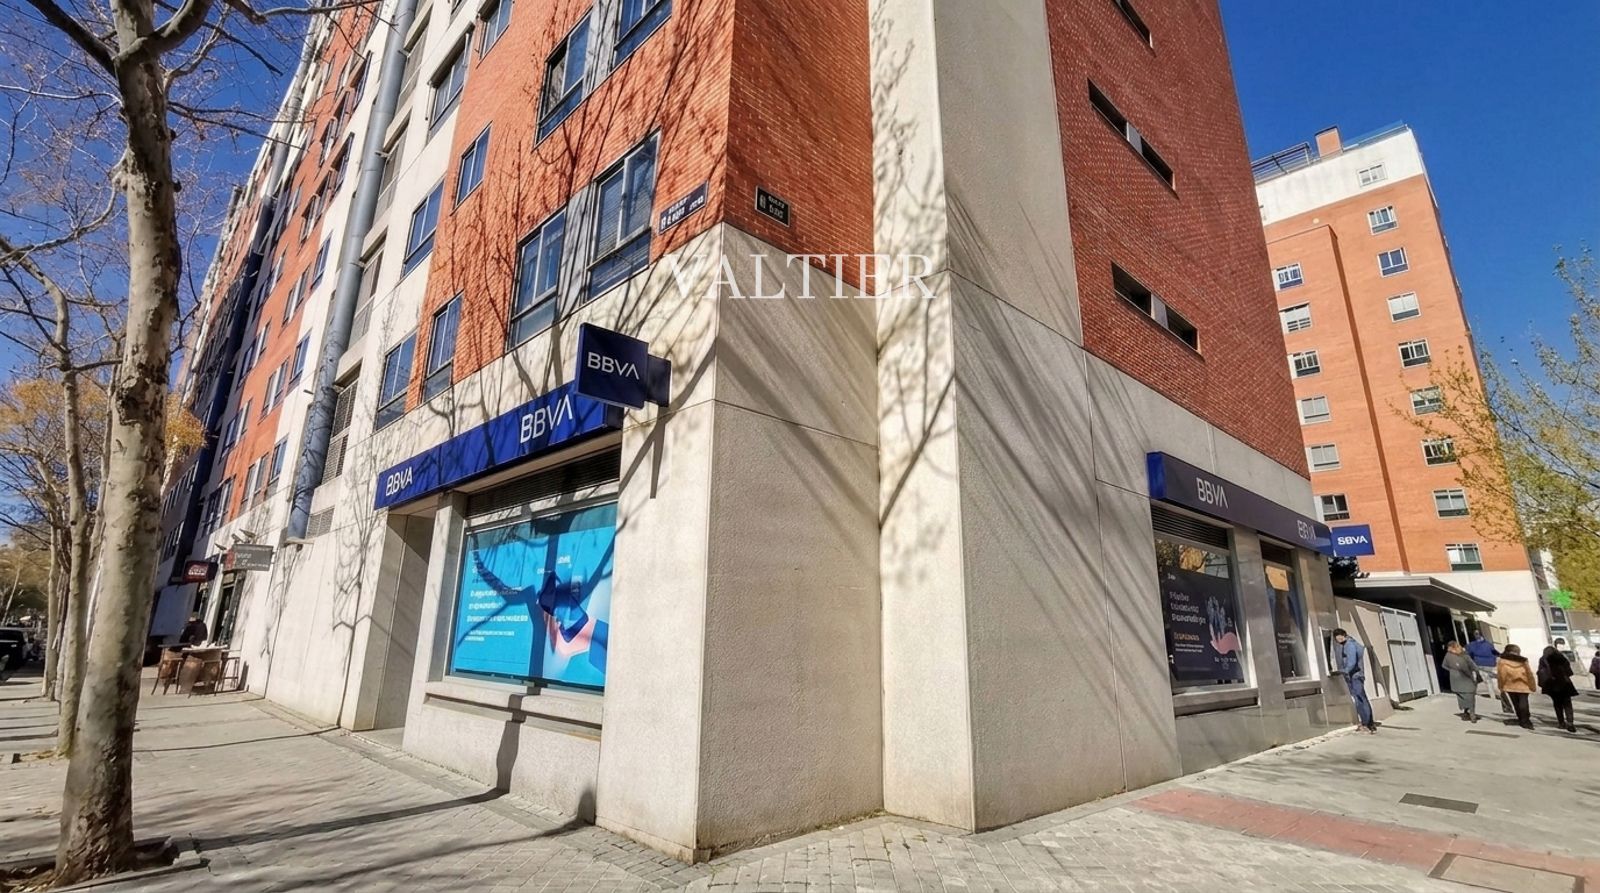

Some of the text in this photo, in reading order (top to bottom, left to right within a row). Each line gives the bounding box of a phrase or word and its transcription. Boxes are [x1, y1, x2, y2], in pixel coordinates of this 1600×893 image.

[587, 351, 640, 380] BBVA
[520, 394, 573, 444] BBVA
[385, 466, 413, 497] BBVA
[1196, 477, 1229, 509] BBVA
